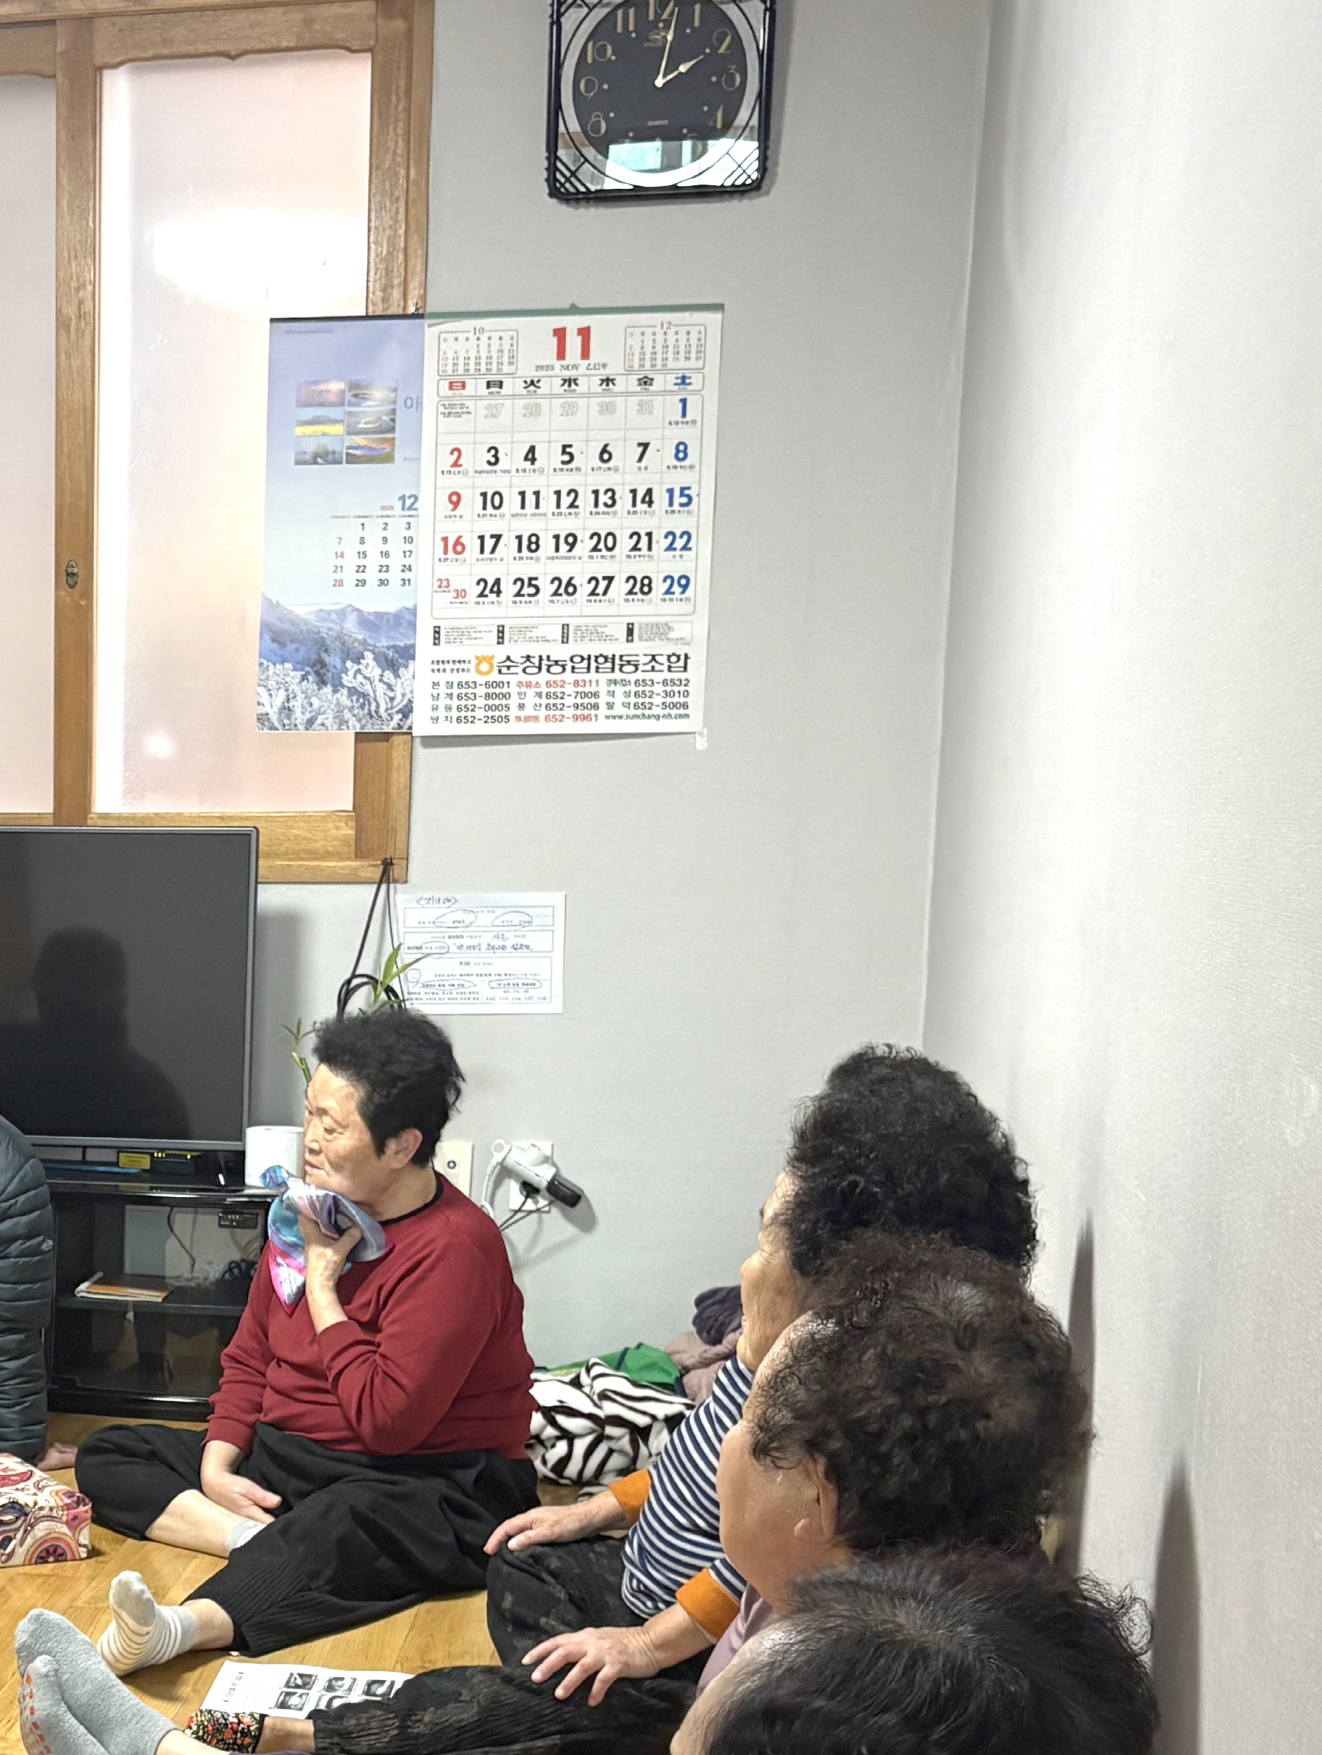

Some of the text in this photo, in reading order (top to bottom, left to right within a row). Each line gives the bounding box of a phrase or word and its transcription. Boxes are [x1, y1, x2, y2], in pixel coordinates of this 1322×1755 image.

[586, 41, 613, 64] 10
[579, 76, 598, 99] 9
[722, 65, 740, 91] 3
[587, 112, 607, 137] 8
[552, 325, 591, 361] 11
[560, 363, 580, 372] NOV
[448, 380, 466, 391] 日
[523, 379, 541, 389] 火
[560, 377, 579, 388] 水
[598, 376, 616, 387] 木
[636, 375, 654, 387] 金
[673, 374, 693, 386] 土
[679, 397, 688, 419] 1
[449, 447, 463, 468] 2
[486, 446, 500, 466] 3
[523, 445, 537, 466] 4
[560, 444, 575, 466] 5
[598, 443, 613, 464] 6
[636, 442, 651, 464] 7
[674, 441, 689, 463] 8
[398, 493, 419, 512] 12
[448, 490, 462, 512] 9
[479, 490, 504, 511] 10
[517, 490, 541, 510] 11
[553, 489, 579, 510] 12
[591, 488, 617, 509] 13
[629, 487, 655, 509] 14
[665, 486, 693, 508] 15
[382, 522, 389, 531] 2
[358, 536, 366, 545] 8
[381, 536, 388, 545] 9
[402, 535, 414, 545] 10
[440, 535, 466, 556] 16
[477, 534, 503, 555] 17
[514, 533, 540, 554] 18
[552, 532, 578, 553] 19
[589, 531, 617, 553] 20
[628, 531, 653, 552] 21
[663, 531, 693, 552] 22
[357, 550, 368, 559] 15
[379, 550, 390, 559] 16
[402, 550, 413, 559] 17
[355, 564, 367, 574] 22
[378, 564, 390, 573] 23
[400, 564, 412, 573] 24
[354, 578, 367, 588] 29
[377, 578, 390, 587] 30
[400, 578, 411, 587] 31
[436, 578, 451, 589] 23
[475, 577, 503, 598] 24
[512, 577, 541, 598] 25
[549, 576, 578, 597] 26
[587, 575, 616, 597] 27
[624, 575, 653, 597] 28
[661, 574, 691, 596] 29
[452, 589, 467, 600] 30
[496, 652, 691, 675] 순창농업협동조합
[457, 680, 510, 690] 653-6001
[545, 679, 600, 689] 652-8311
[634, 678, 690, 688] 653-6532
[456, 692, 511, 701] 653-8000
[545, 691, 600, 700] 652-7006
[634, 690, 690, 699] 652-3010
[456, 703, 511, 713] 652-0005
[633, 701, 689, 711] 652-5006
[456, 715, 510, 724] 652-2505
[544, 713, 598, 723] 652-9961
